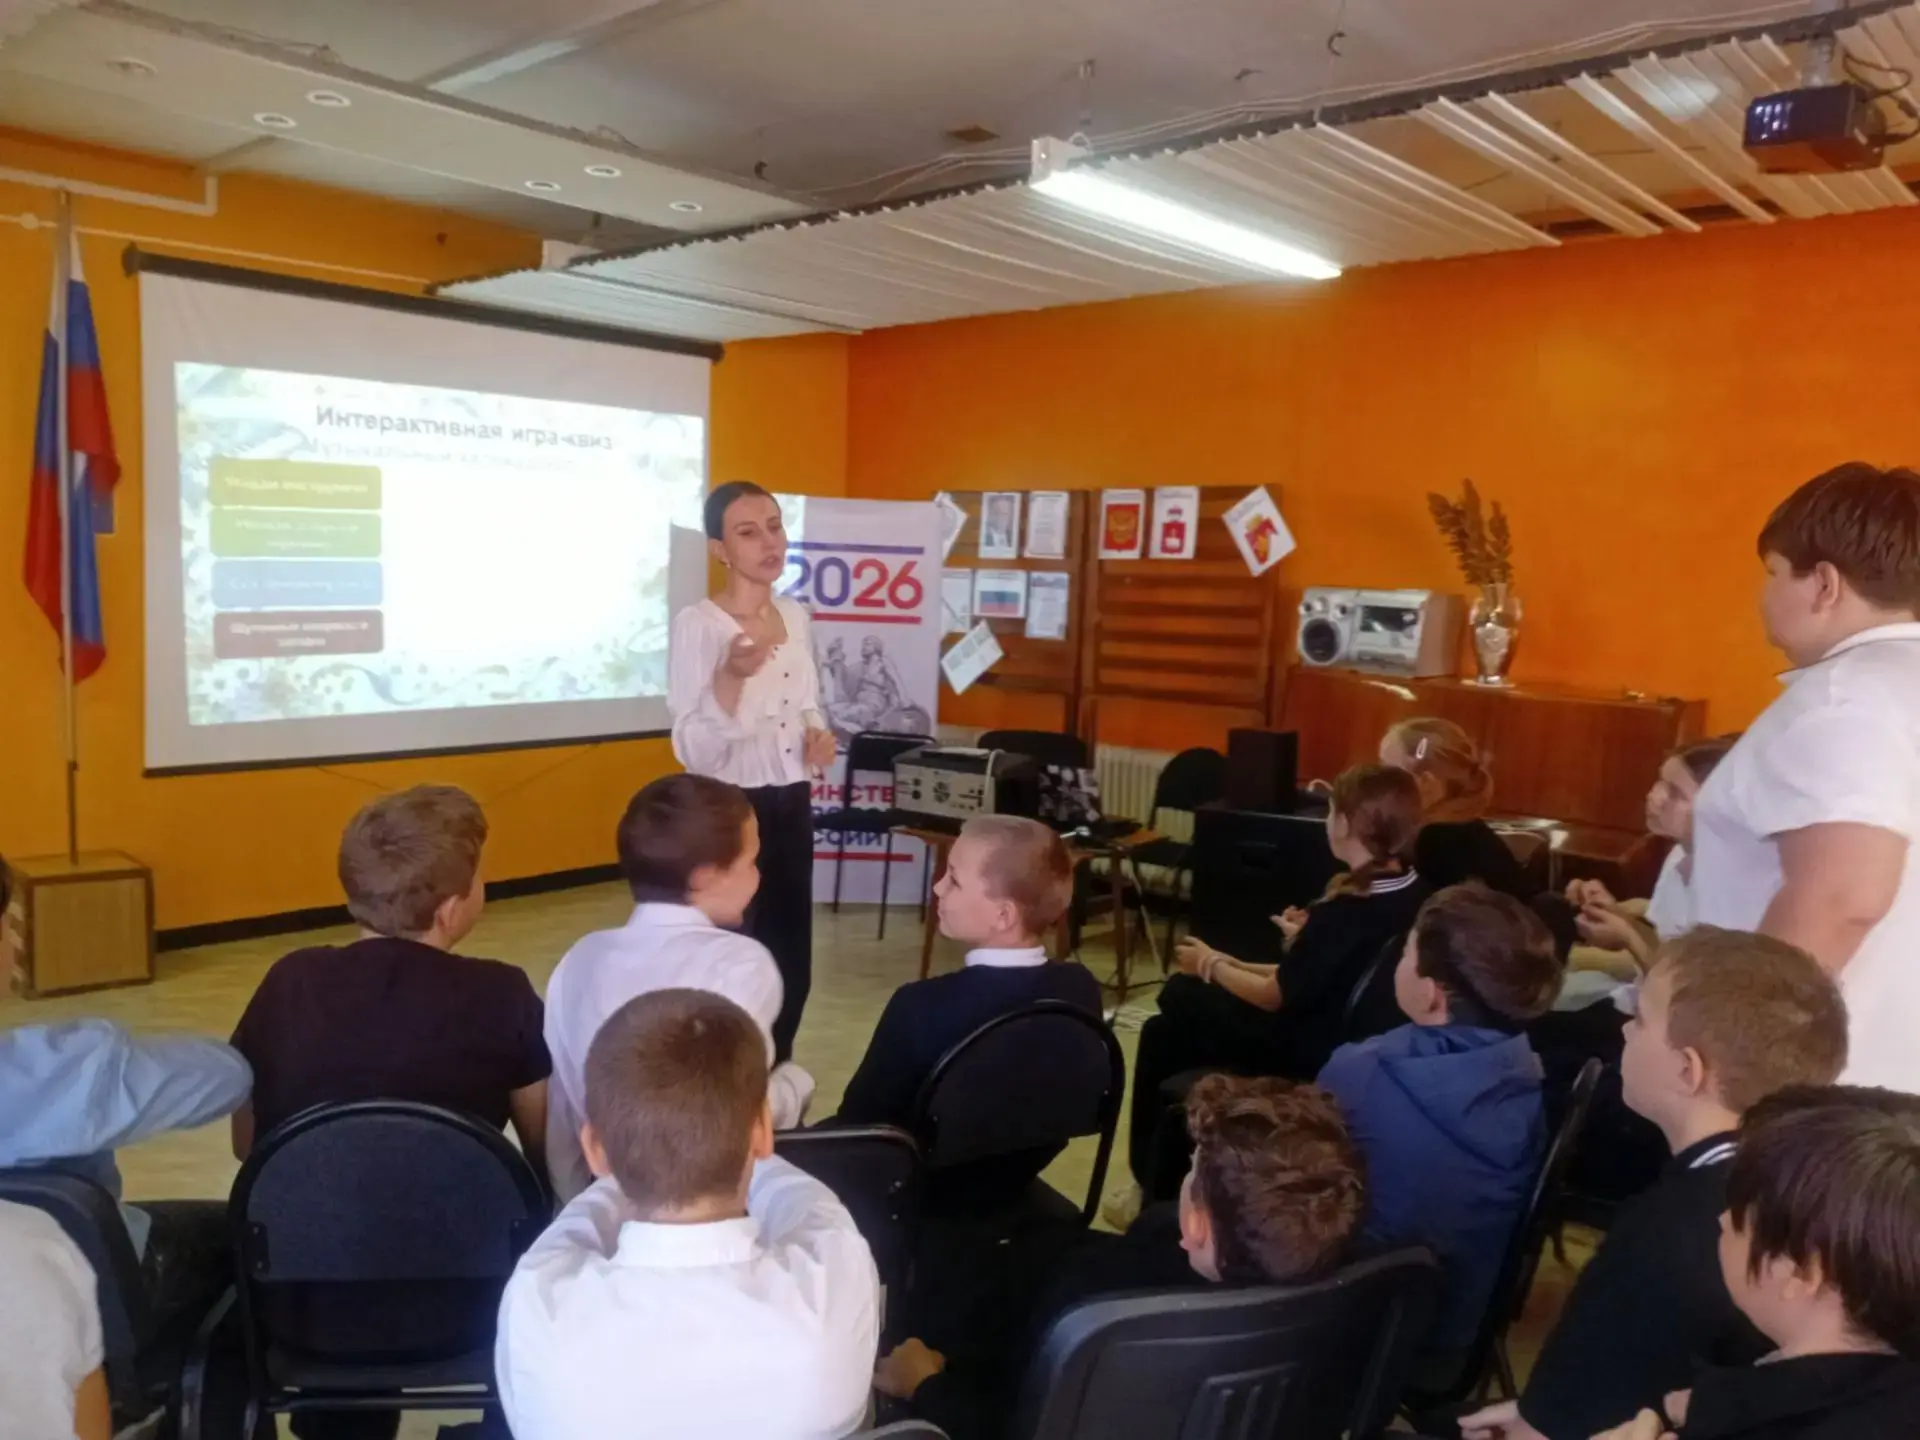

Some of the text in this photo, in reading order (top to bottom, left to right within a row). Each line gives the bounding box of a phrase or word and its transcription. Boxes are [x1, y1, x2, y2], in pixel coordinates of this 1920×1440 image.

[316, 404, 613, 451] Интерактивная игра-квиз
[781, 554, 923, 609] 2026
